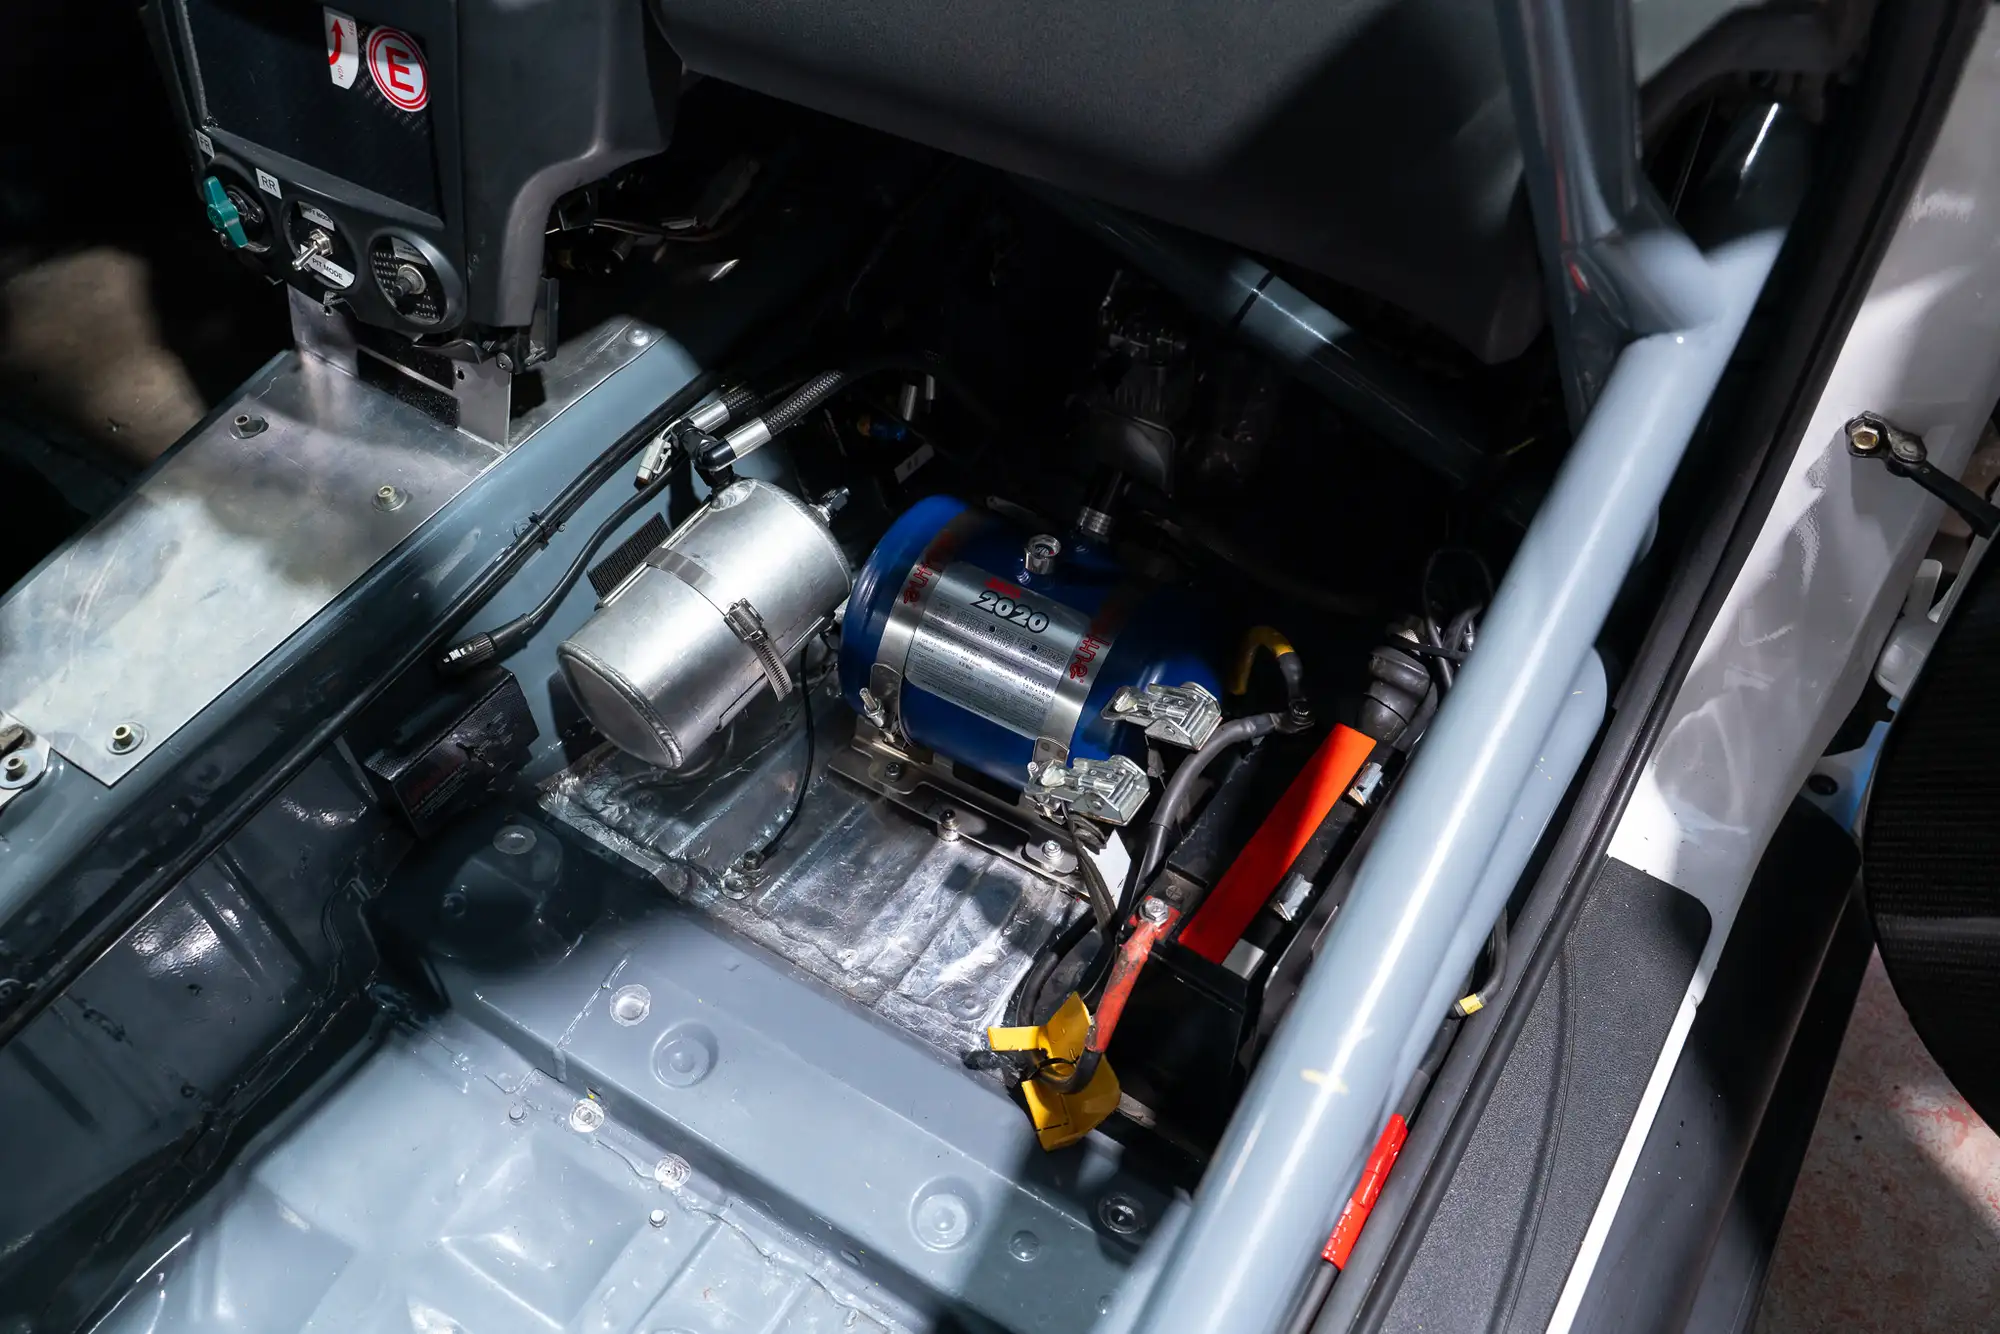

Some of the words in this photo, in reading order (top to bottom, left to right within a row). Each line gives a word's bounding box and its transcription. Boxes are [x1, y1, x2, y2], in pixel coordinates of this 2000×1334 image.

[385, 45, 415, 94] E
[260, 175, 277, 192] RR
[312, 256, 323, 268] PIT
[323, 263, 344, 281] MODE
[969, 590, 1050, 634] 2020
